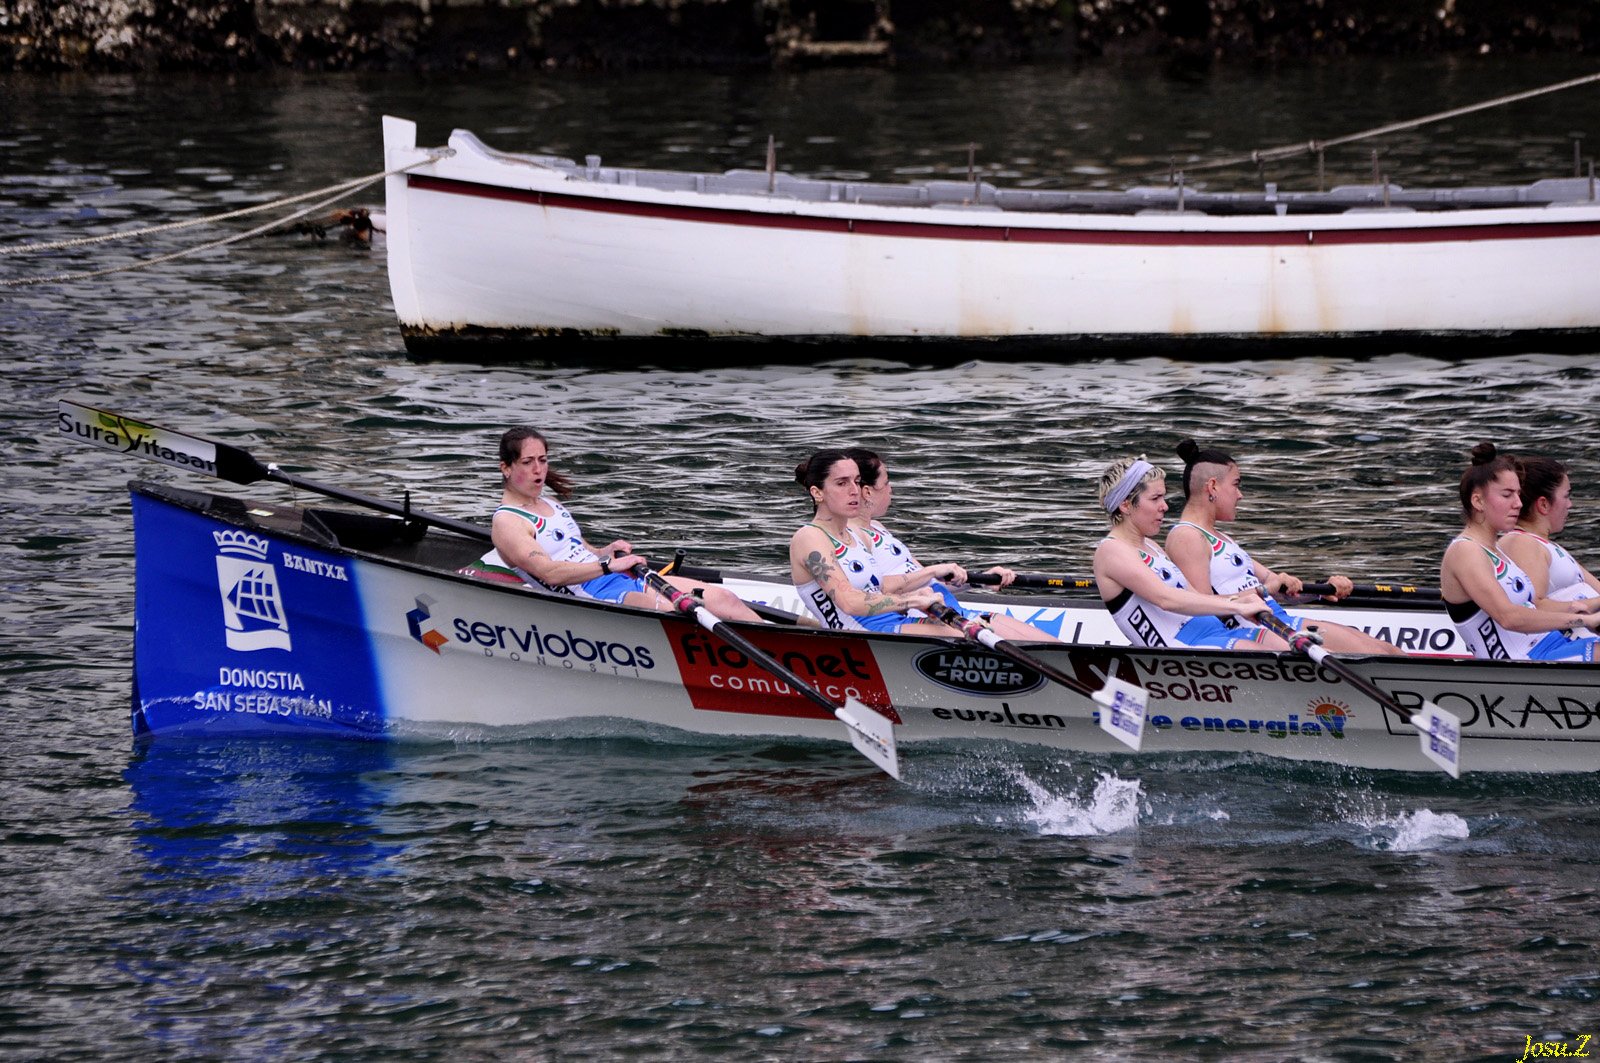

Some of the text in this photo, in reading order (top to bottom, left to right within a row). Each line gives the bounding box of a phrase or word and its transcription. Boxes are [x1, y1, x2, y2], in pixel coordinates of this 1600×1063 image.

[58, 413, 118, 446] Sura
[282, 552, 348, 582] BANTXA
[453, 617, 655, 670] serviobras
[1347, 625, 1456, 651] IARIO
[483, 647, 640, 677] DONOSTI
[680, 633, 871, 680] fionet
[939, 655, 999, 670] LAND
[219, 667, 305, 691] DONOSTIA
[950, 670, 1023, 686] ROVER
[1135, 658, 1342, 684] vascastec
[709, 674, 862, 700] comuica
[1145, 678, 1239, 703] solar
[193, 691, 231, 712] SAN
[1391, 690, 1600, 729] BOKAD
[1180, 713, 1322, 739] energia
